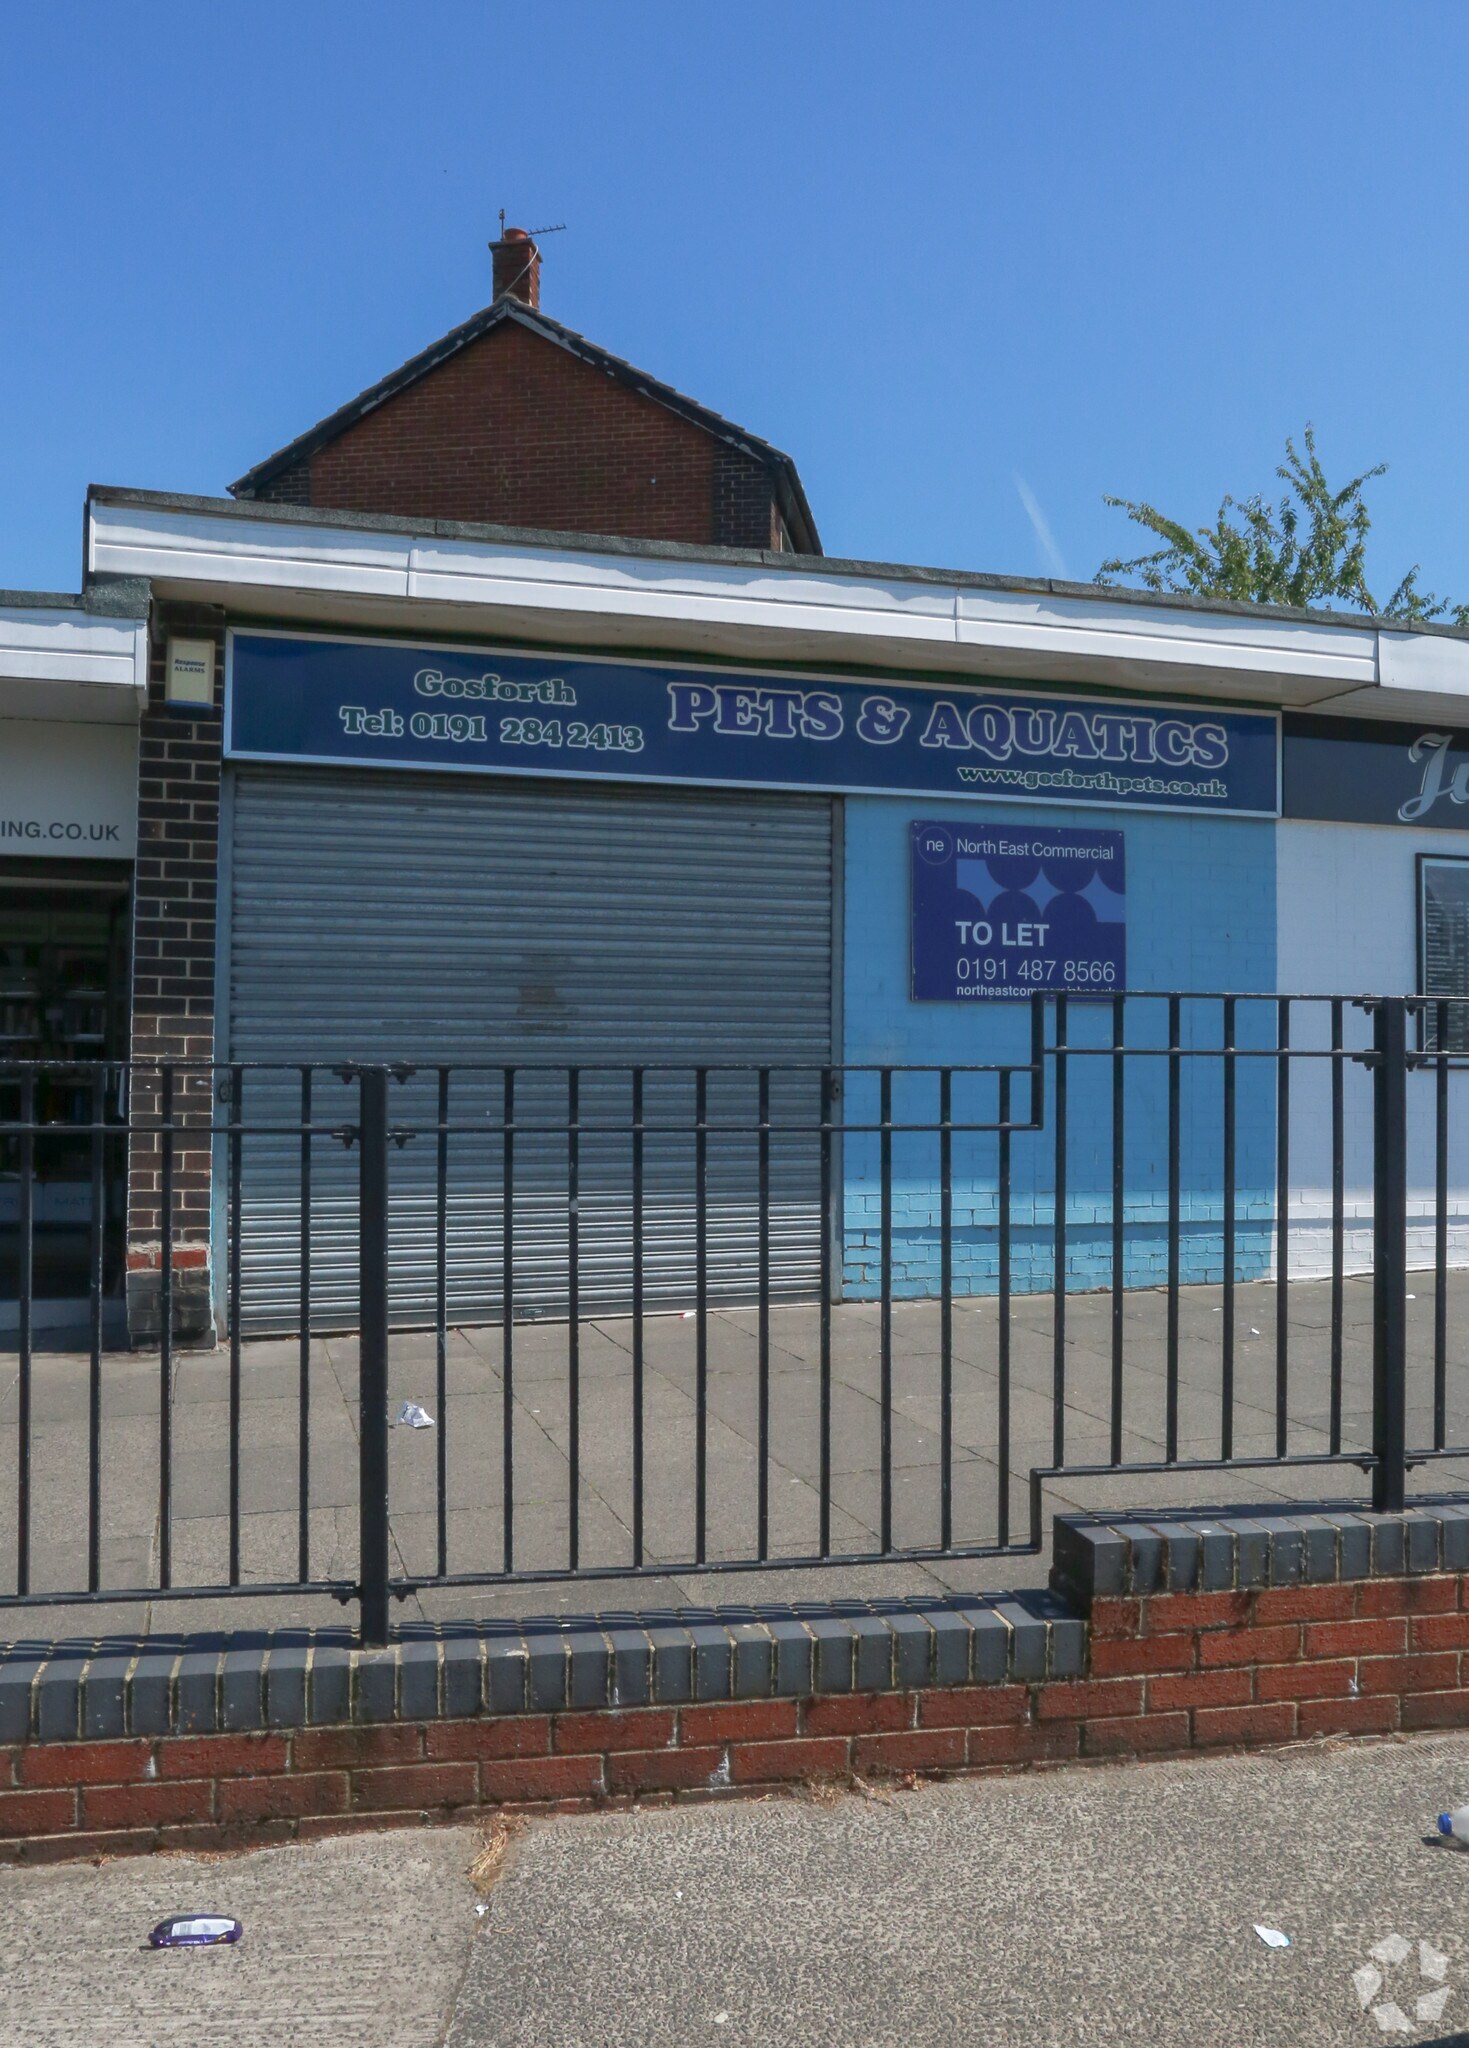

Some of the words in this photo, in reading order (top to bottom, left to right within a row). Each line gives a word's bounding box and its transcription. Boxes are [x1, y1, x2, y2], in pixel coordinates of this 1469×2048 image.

[414, 668, 577, 707] Gosforth
[340, 705, 404, 737] Tel:
[410, 713, 487, 742] 0191
[500, 718, 562, 748] 284
[567, 722, 644, 753] 2413
[666, 682, 844, 741] PETS
[856, 696, 911, 744] &
[920, 701, 1229, 769] AQUATICS
[957, 764, 1228, 799] www.gosforthpets.co.uk
[926, 839, 944, 852] ne
[957, 838, 996, 855] North
[999, 840, 1030, 857] East
[1032, 842, 1114, 861] Commercial
[955, 921, 993, 946] TO
[1002, 922, 1050, 947] LET
[956, 957, 1008, 981] 0191
[1017, 960, 1057, 982] 487
[1063, 960, 1116, 983] 8566
